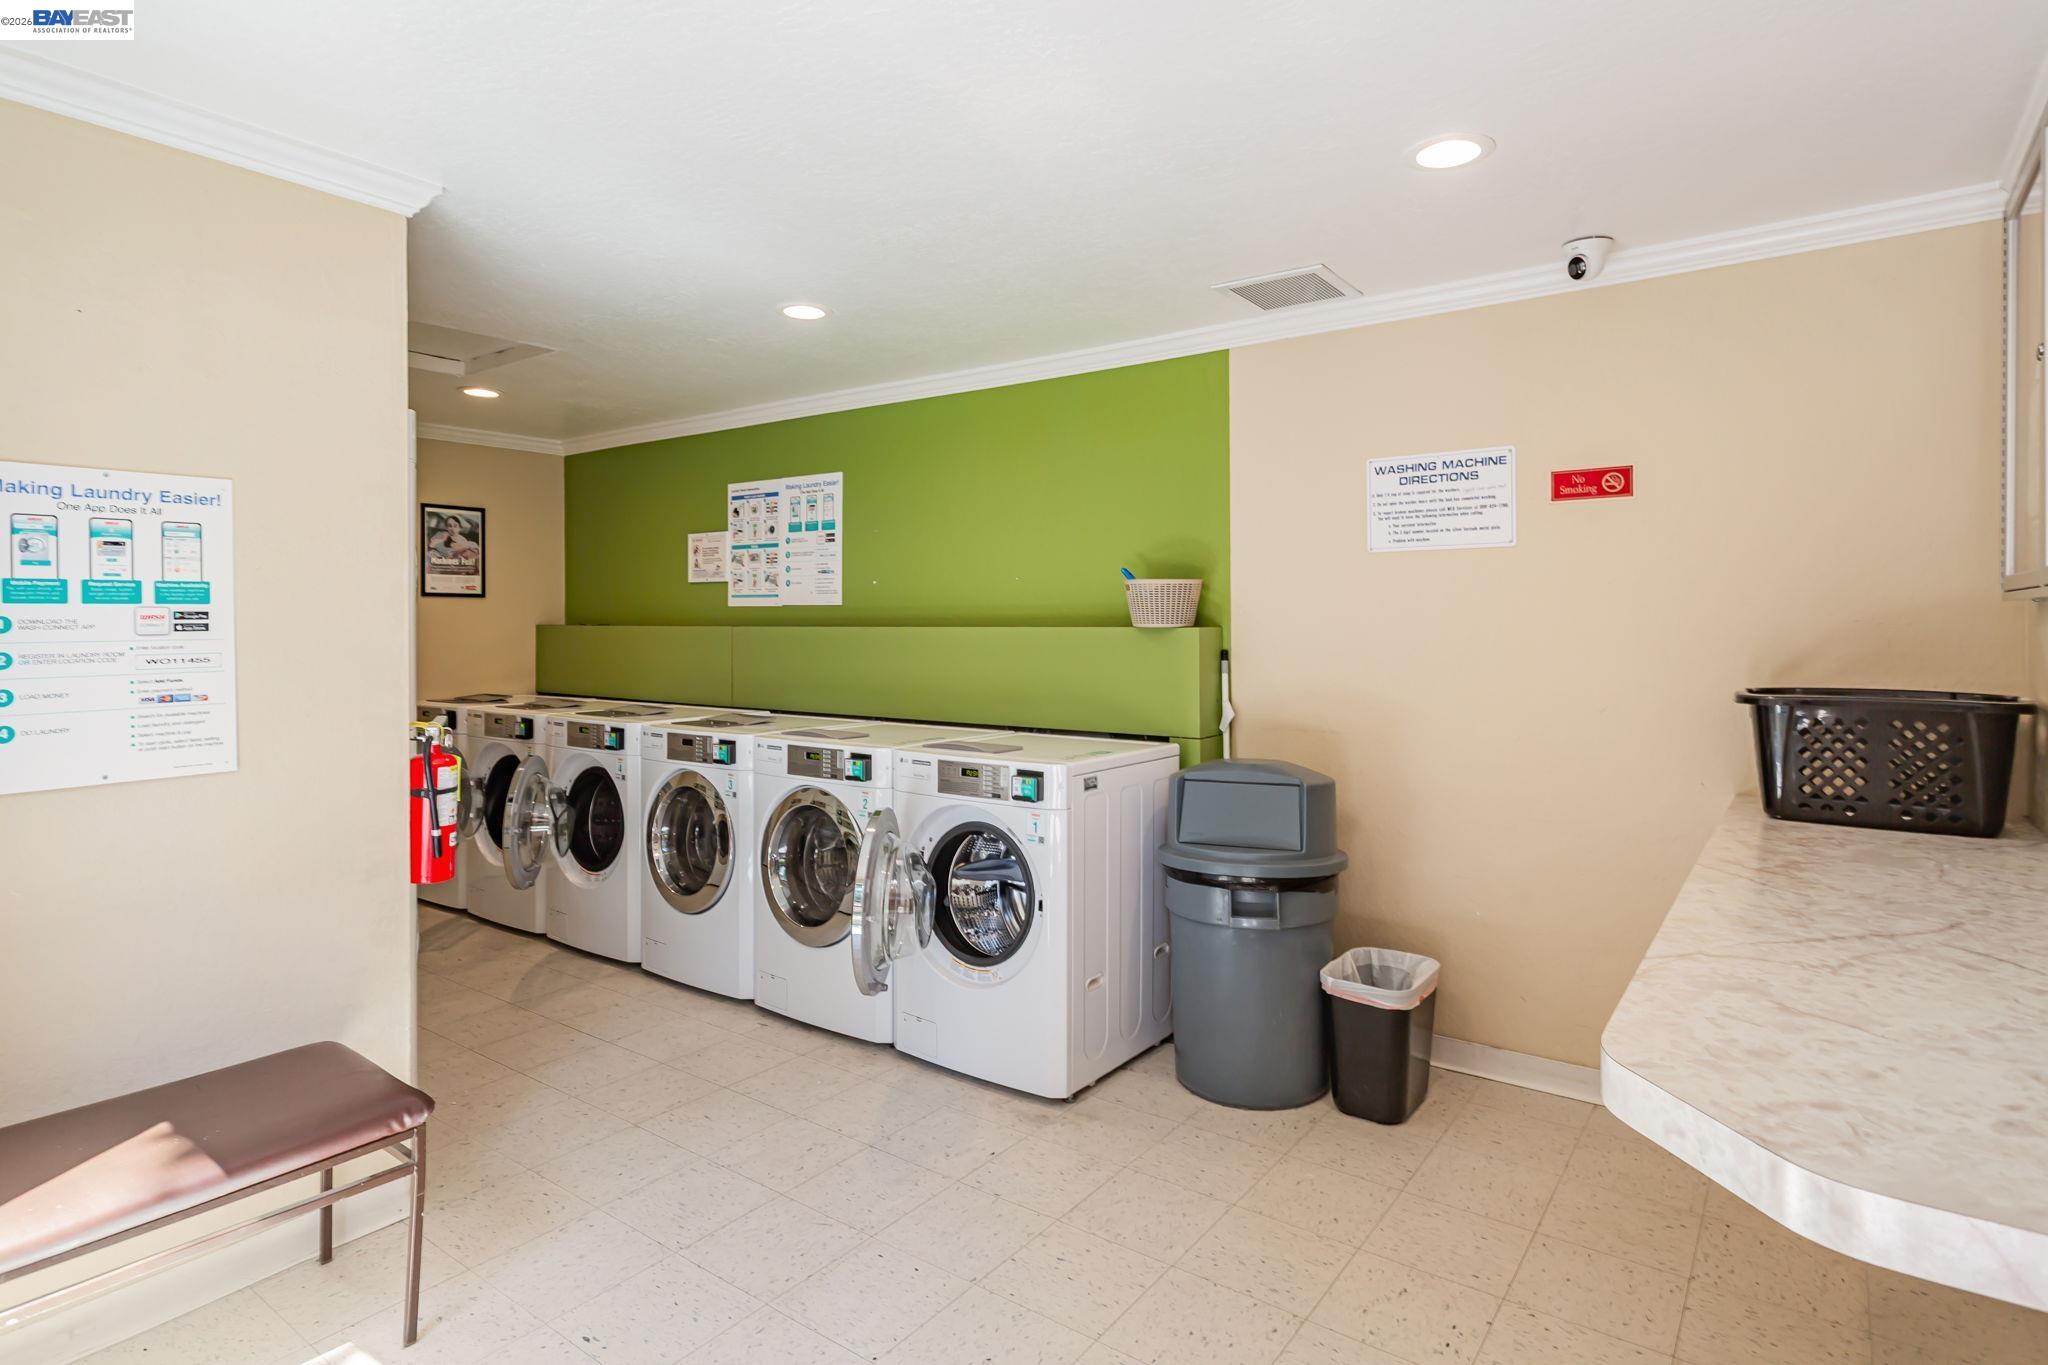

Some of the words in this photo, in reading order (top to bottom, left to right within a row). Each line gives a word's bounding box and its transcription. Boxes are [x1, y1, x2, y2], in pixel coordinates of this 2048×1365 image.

[1374, 461, 1437, 476] WASHING
[1442, 455, 1507, 470] MACHINE
[1399, 470, 1479, 486] DIRECTIONS
[1571, 475, 1586, 484] No
[71, 484, 152, 505] Laundry
[160, 490, 222, 507] Easier!
[1560, 485, 1598, 495] Smoking
[56, 501, 81, 511] One
[84, 503, 106, 513] App
[109, 504, 137, 515] Does
[151, 507, 162, 516] All
[863, 798, 868, 810] 2
[1032, 821, 1037, 834] 1
